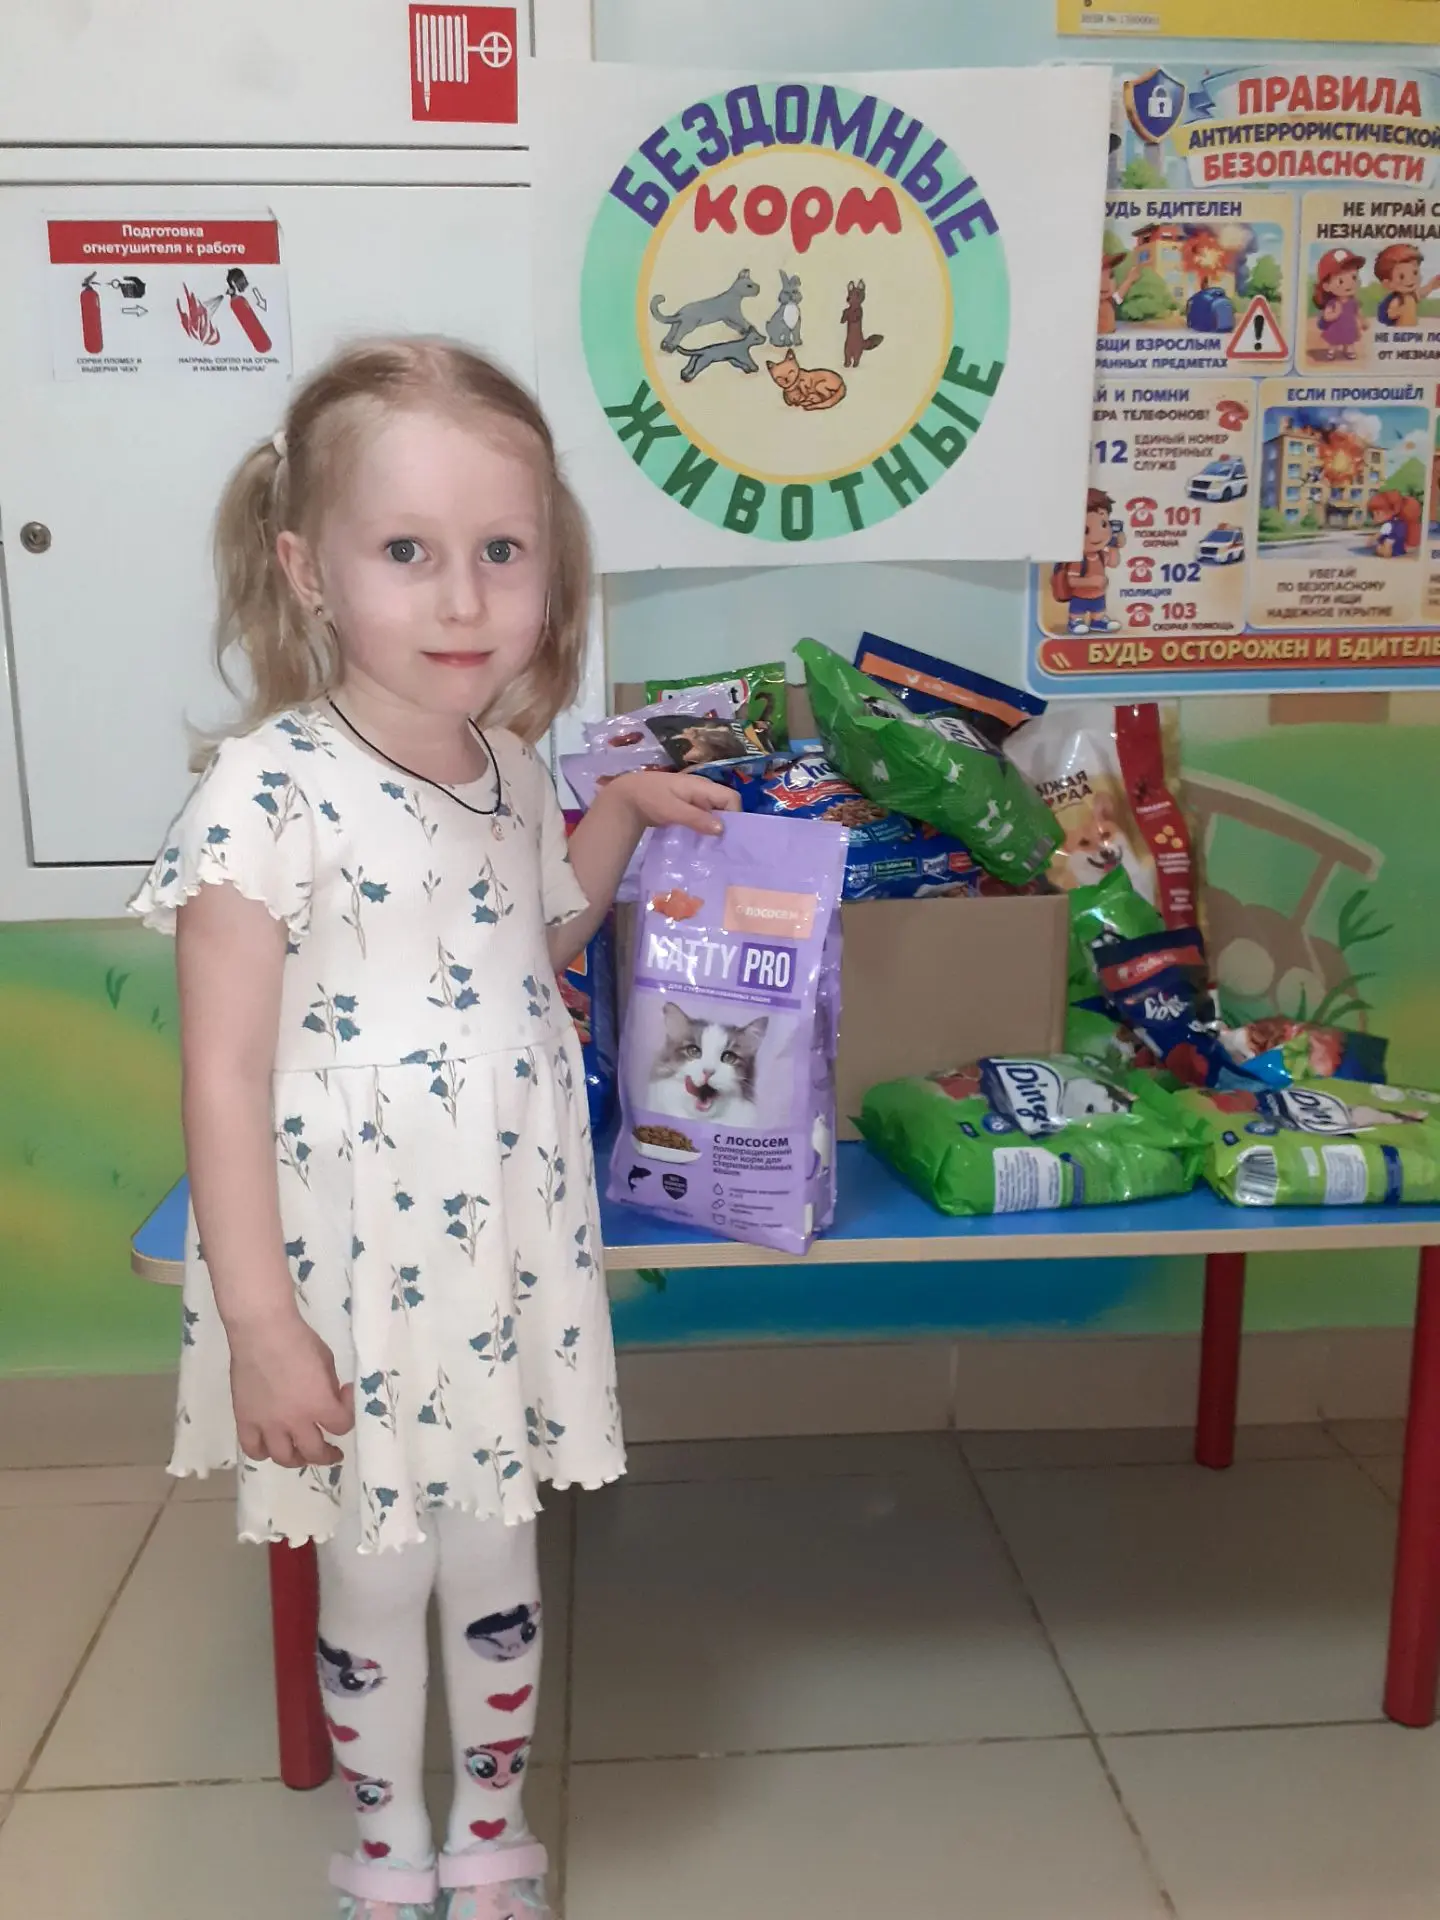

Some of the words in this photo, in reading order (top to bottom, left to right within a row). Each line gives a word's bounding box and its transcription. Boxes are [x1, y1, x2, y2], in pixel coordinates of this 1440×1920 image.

[1238, 75, 1422, 118] ПРАВИЛА
[1188, 122, 1440, 149] АНТИТЕРРОРИСТИЧЕСКОЙ
[608, 84, 1000, 258] БЕЗДОМНЫЕ
[1203, 150, 1426, 183] БЕЗОПАСНОСТИ
[1104, 201, 1141, 219] УДЬ
[1146, 200, 1242, 219] БДИТЕЛЕН
[1343, 202, 1365, 217] НЕ
[1370, 198, 1426, 217] ИГРАЙ
[122, 224, 204, 239] Подготовка
[1317, 223, 1440, 241] НЕЗНАКОМЦА
[82, 242, 182, 257] огнетушителя
[186, 244, 194, 254] к
[197, 241, 246, 257] работе
[1096, 338, 1130, 353] БЩИ
[1135, 338, 1221, 351] ВЗРОСЛЫМ
[1152, 358, 1228, 370] ПРЕДМЕТАХ
[1115, 388, 1125, 402] И
[1132, 388, 1190, 402] ПОМНИ
[1287, 388, 1326, 401] ЕСЛИ
[1330, 384, 1424, 401] ПРОИЗОШЁЛ
[1093, 410, 1117, 421] ЕРА
[603, 345, 1005, 542] ЖИВОТНЫЕ
[1135, 433, 1185, 445] ЕДИНЫЙ
[1187, 433, 1229, 445] НОМЕР
[1090, 439, 1129, 464] 12
[1134, 447, 1213, 459] ЭКСТРЕННЫХ
[1133, 460, 1176, 472] СЛУЖБ
[1164, 506, 1201, 526] 101
[1160, 562, 1201, 583] 102
[1120, 588, 1172, 599] ПОЛИЦИЯ
[1277, 582, 1294, 593] ПО
[1297, 581, 1386, 593] БЕЗОПАСНОМУ
[1161, 602, 1198, 620] 103
[1087, 642, 1154, 666] БУДЬ
[1161, 639, 1309, 661] ОСТОРОЖЕН
[1315, 637, 1332, 658] И
[743, 948, 791, 988] PRO
[726, 1136, 789, 1148] лососем
